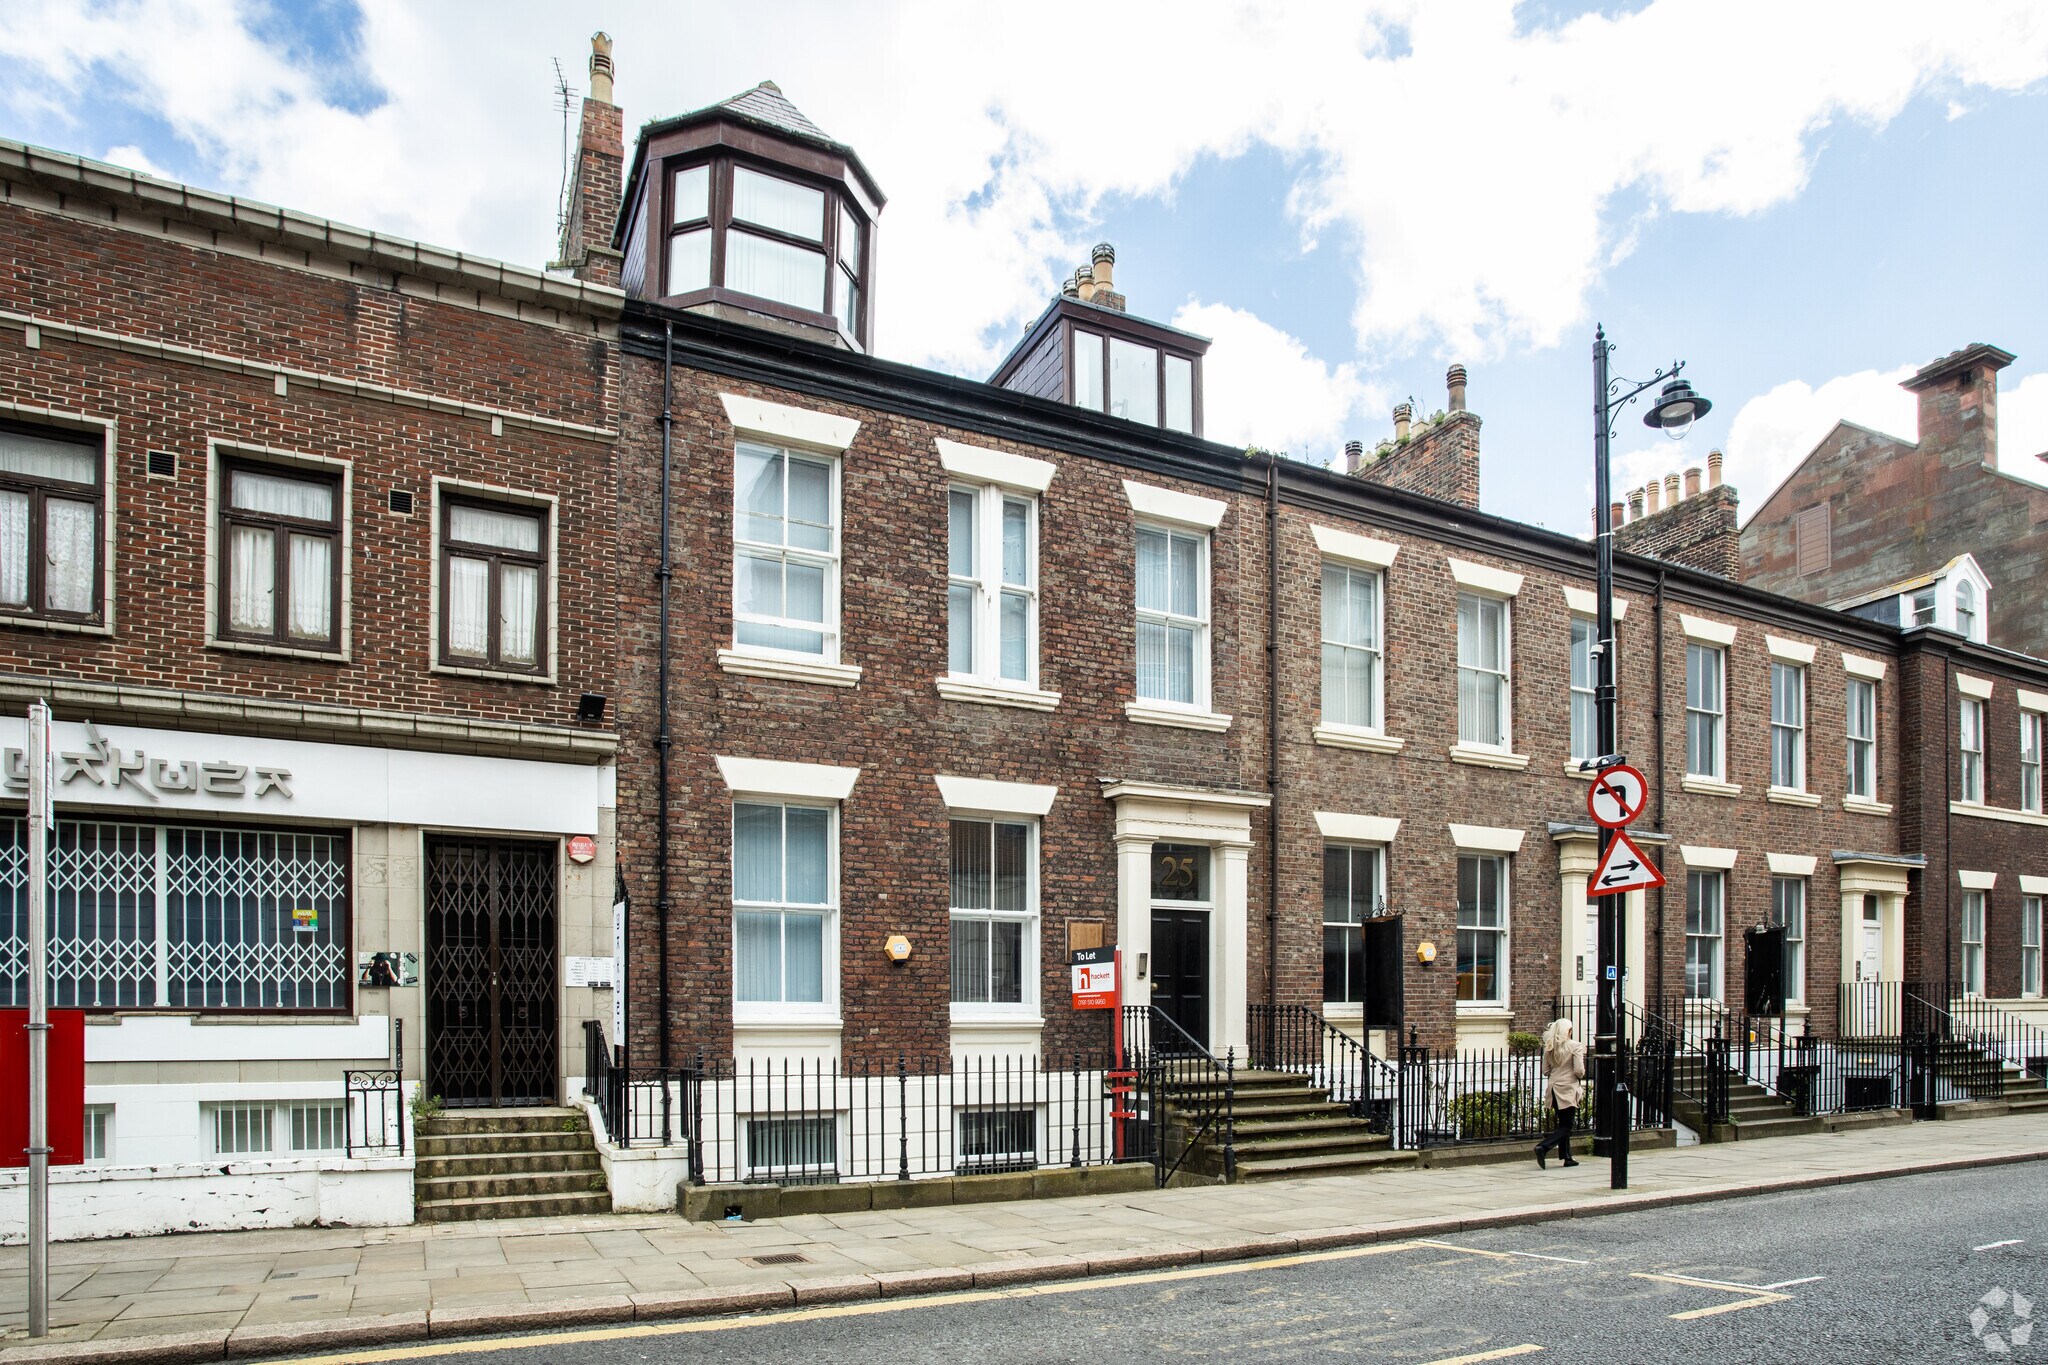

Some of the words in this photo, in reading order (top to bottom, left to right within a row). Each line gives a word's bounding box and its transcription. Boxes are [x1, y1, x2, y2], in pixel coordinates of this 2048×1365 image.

[1161, 856, 1193, 887] 25
[1077, 953, 1085, 961] To
[1085, 952, 1096, 960] Let
